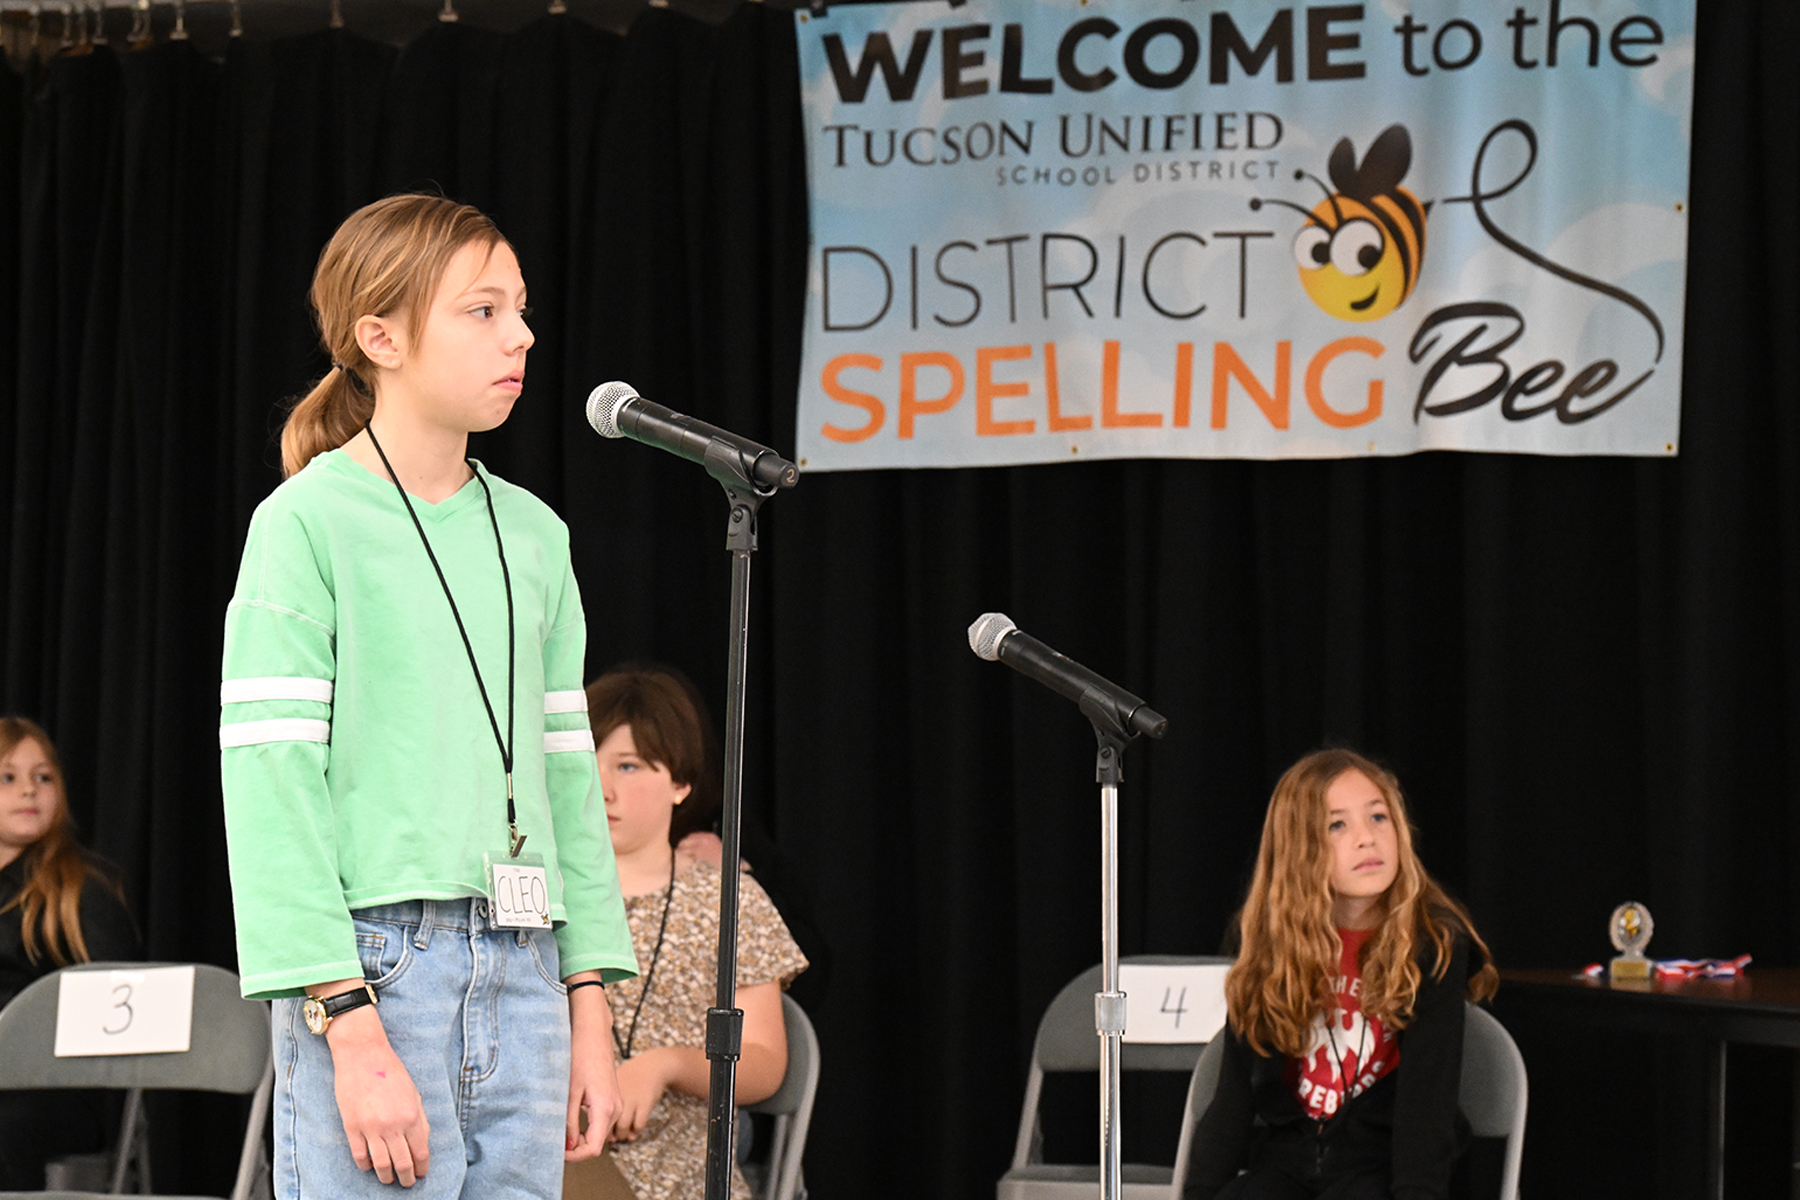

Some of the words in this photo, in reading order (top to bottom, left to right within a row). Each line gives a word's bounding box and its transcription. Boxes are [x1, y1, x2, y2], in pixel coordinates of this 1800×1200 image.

[822, 4, 1366, 102] WELCOME
[1394, 15, 1482, 77] to
[1506, 0, 1664, 69] the
[823, 119, 1034, 167] TUCSON
[1059, 111, 1284, 158] UNIFIED
[995, 164, 1116, 187] SCHOOL
[1133, 160, 1279, 184] DISTRICT
[822, 231, 1275, 332] DISTRICT
[820, 336, 1387, 443] SPELLING
[1409, 301, 1654, 426] Bee
[786, 468, 795, 483] 2
[498, 875, 546, 915] CLEO
[103, 984, 133, 1035] 3
[1160, 986, 1188, 1029] 4
